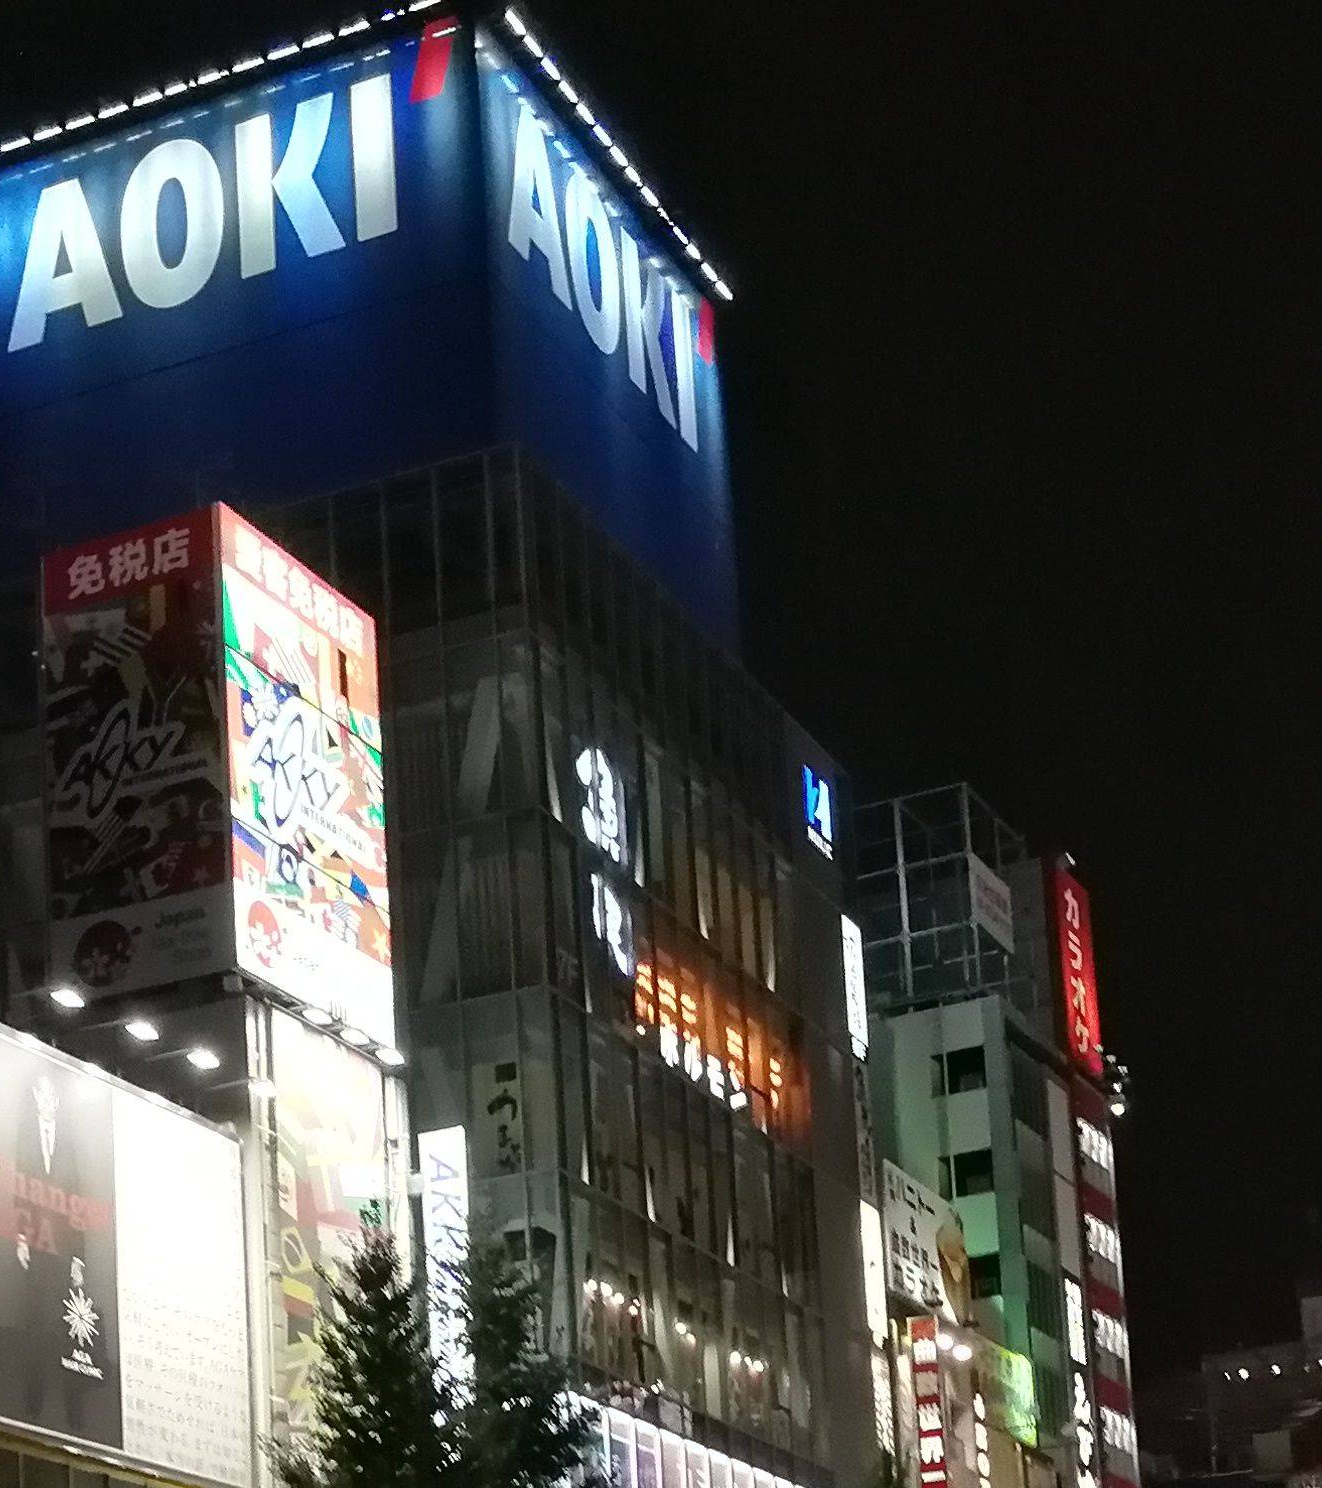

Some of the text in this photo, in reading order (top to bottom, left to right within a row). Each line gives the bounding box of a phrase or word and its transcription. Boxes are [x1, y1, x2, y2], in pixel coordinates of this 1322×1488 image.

[7, 73, 399, 353] AOKI
[506, 100, 699, 453] AOKI
[67, 526, 190, 600] 免税店
